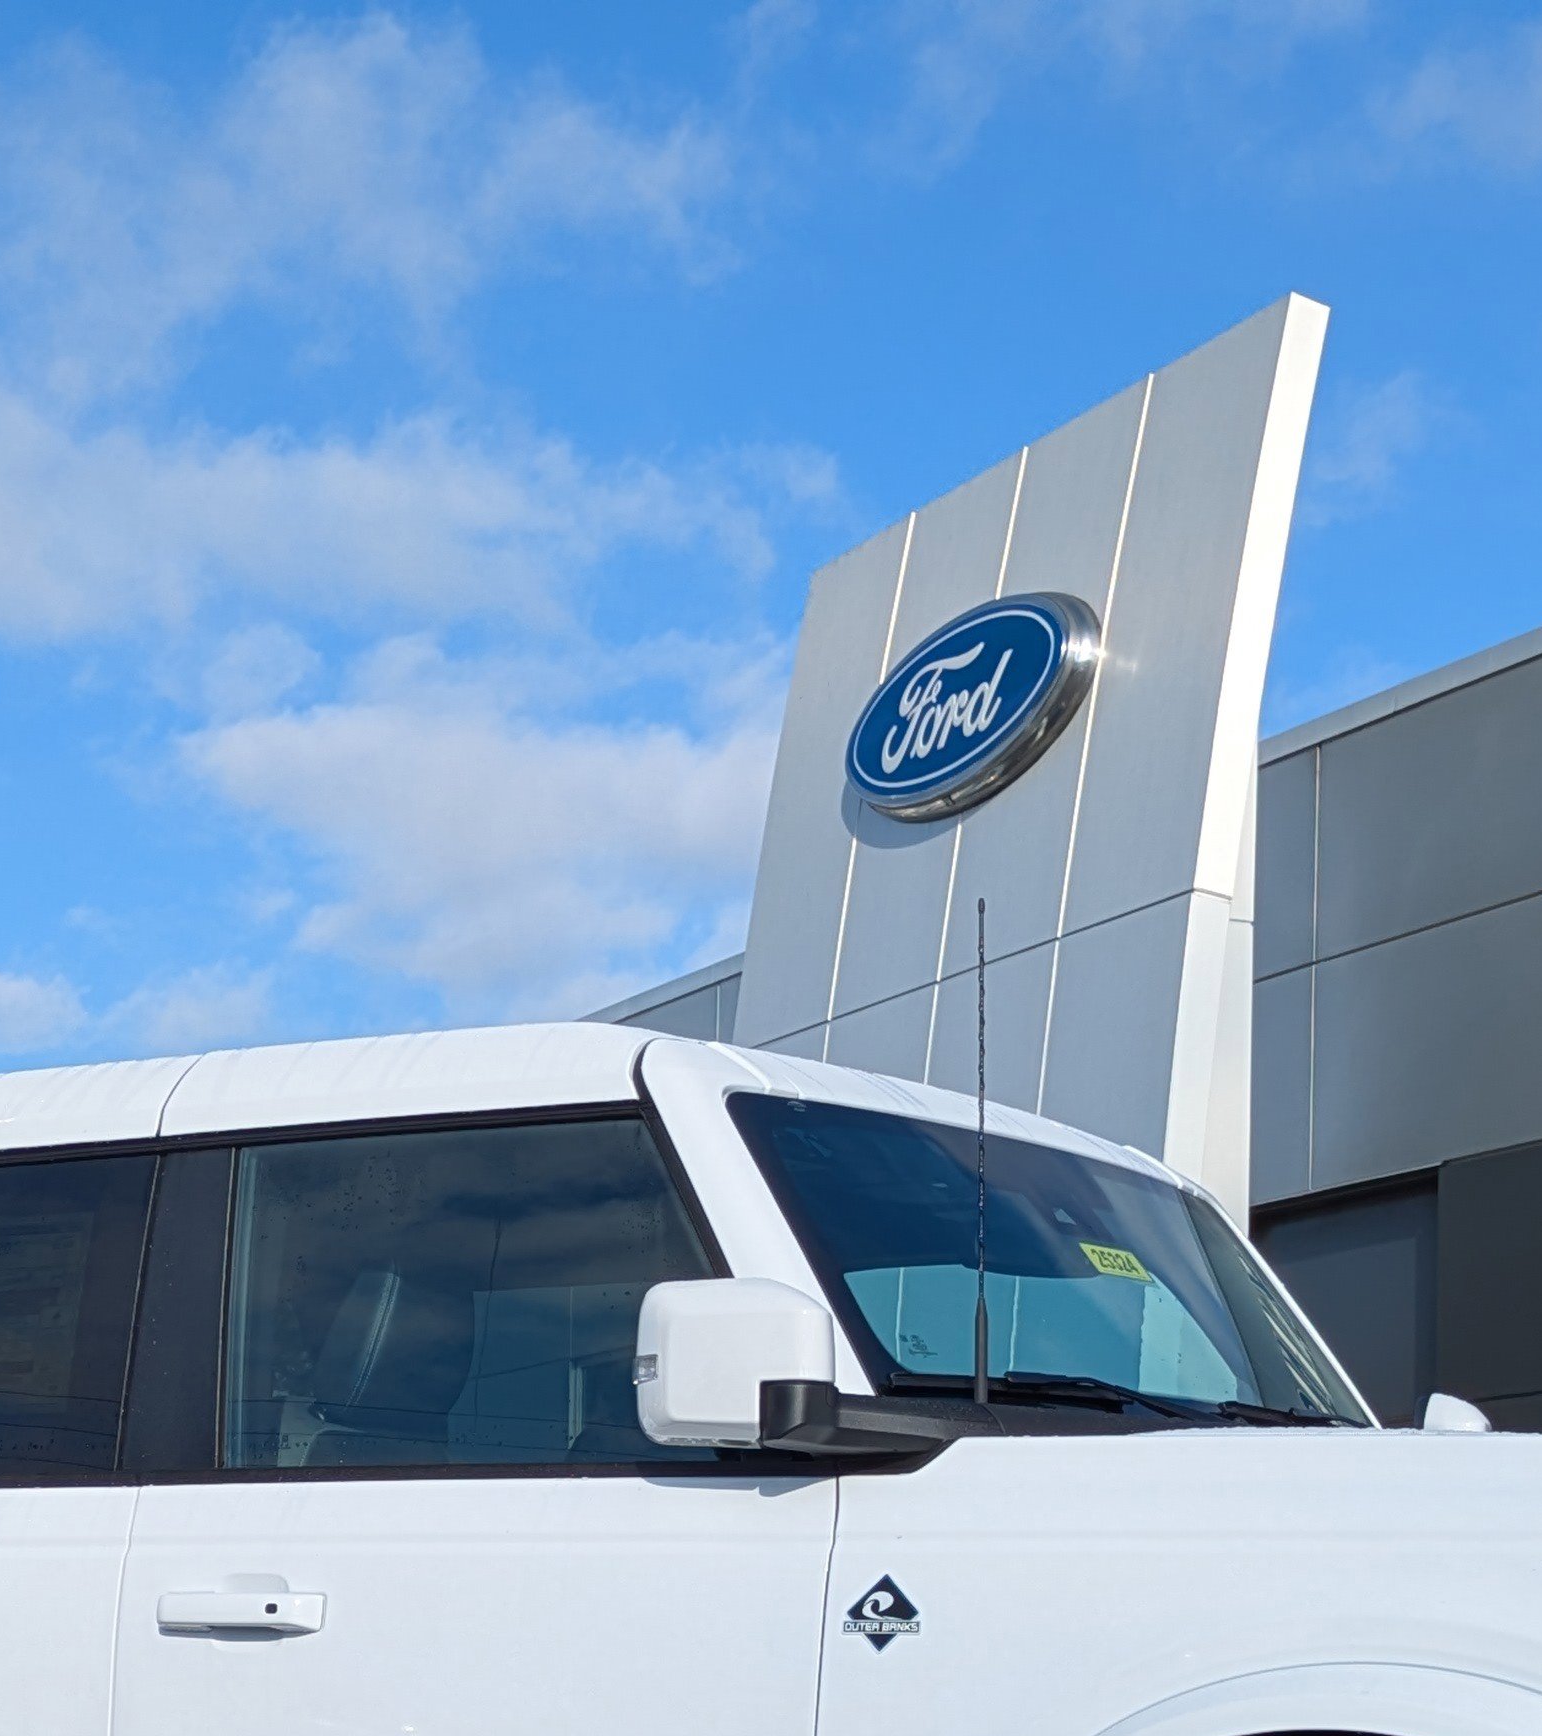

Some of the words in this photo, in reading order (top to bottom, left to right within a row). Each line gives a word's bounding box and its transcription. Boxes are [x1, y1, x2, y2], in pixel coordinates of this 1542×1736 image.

[881, 641, 1013, 774] Ford
[1091, 1249, 1141, 1275] 25324
[844, 1622, 880, 1632] OUTER
[881, 1622, 918, 1632] BANKS
